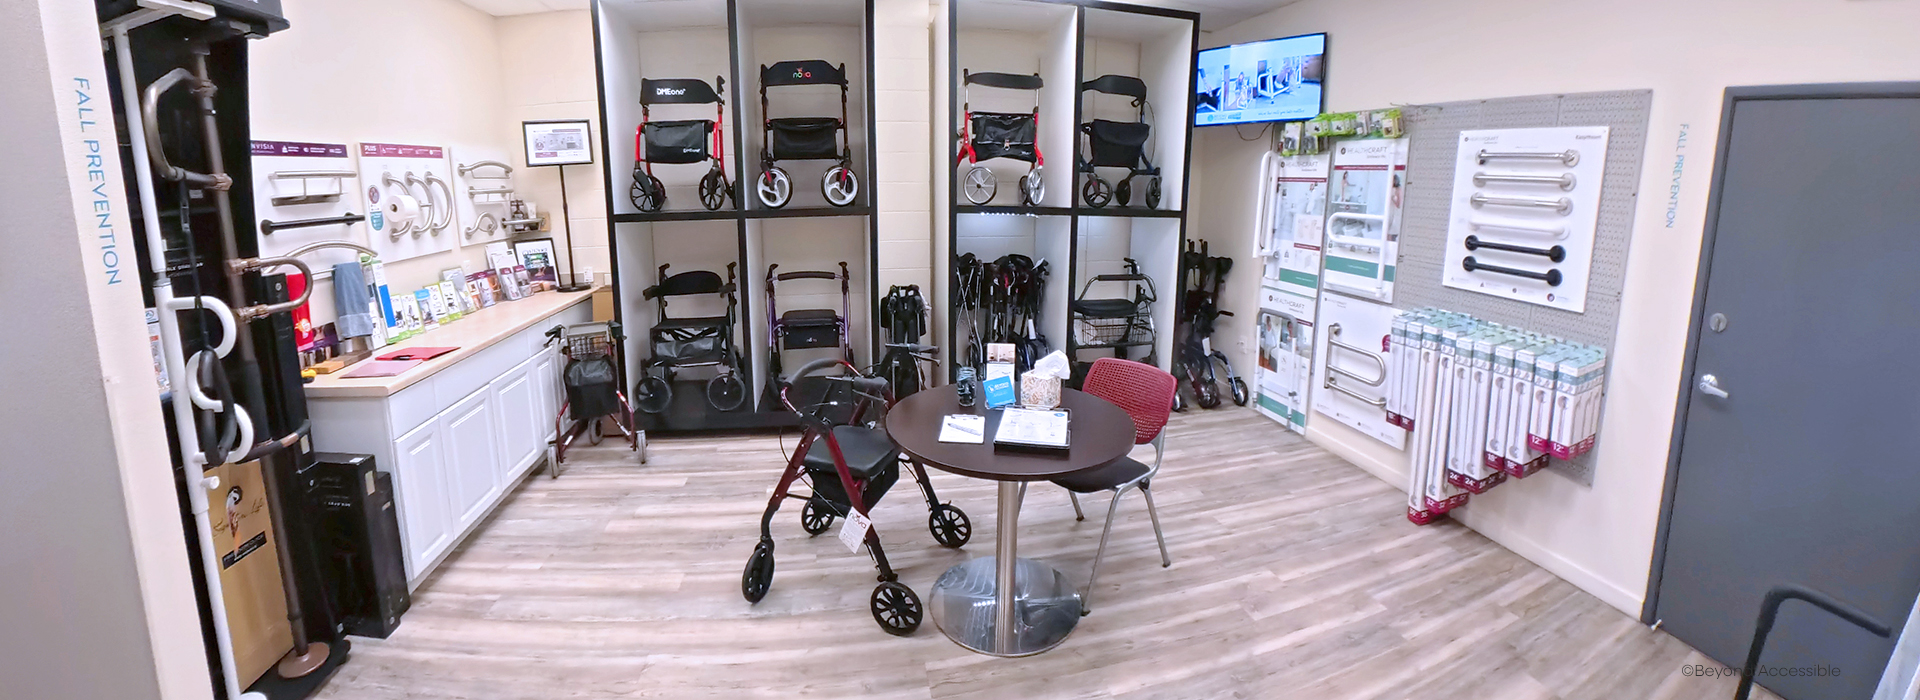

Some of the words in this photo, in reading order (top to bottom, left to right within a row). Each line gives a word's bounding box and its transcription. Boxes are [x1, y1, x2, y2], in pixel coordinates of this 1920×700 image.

[73, 77, 96, 133] FALL
[1675, 123, 1689, 152] FALL
[83, 139, 122, 286] PREVENTION
[1665, 154, 1685, 229] PREVENTION
[849, 512, 867, 529] nova
